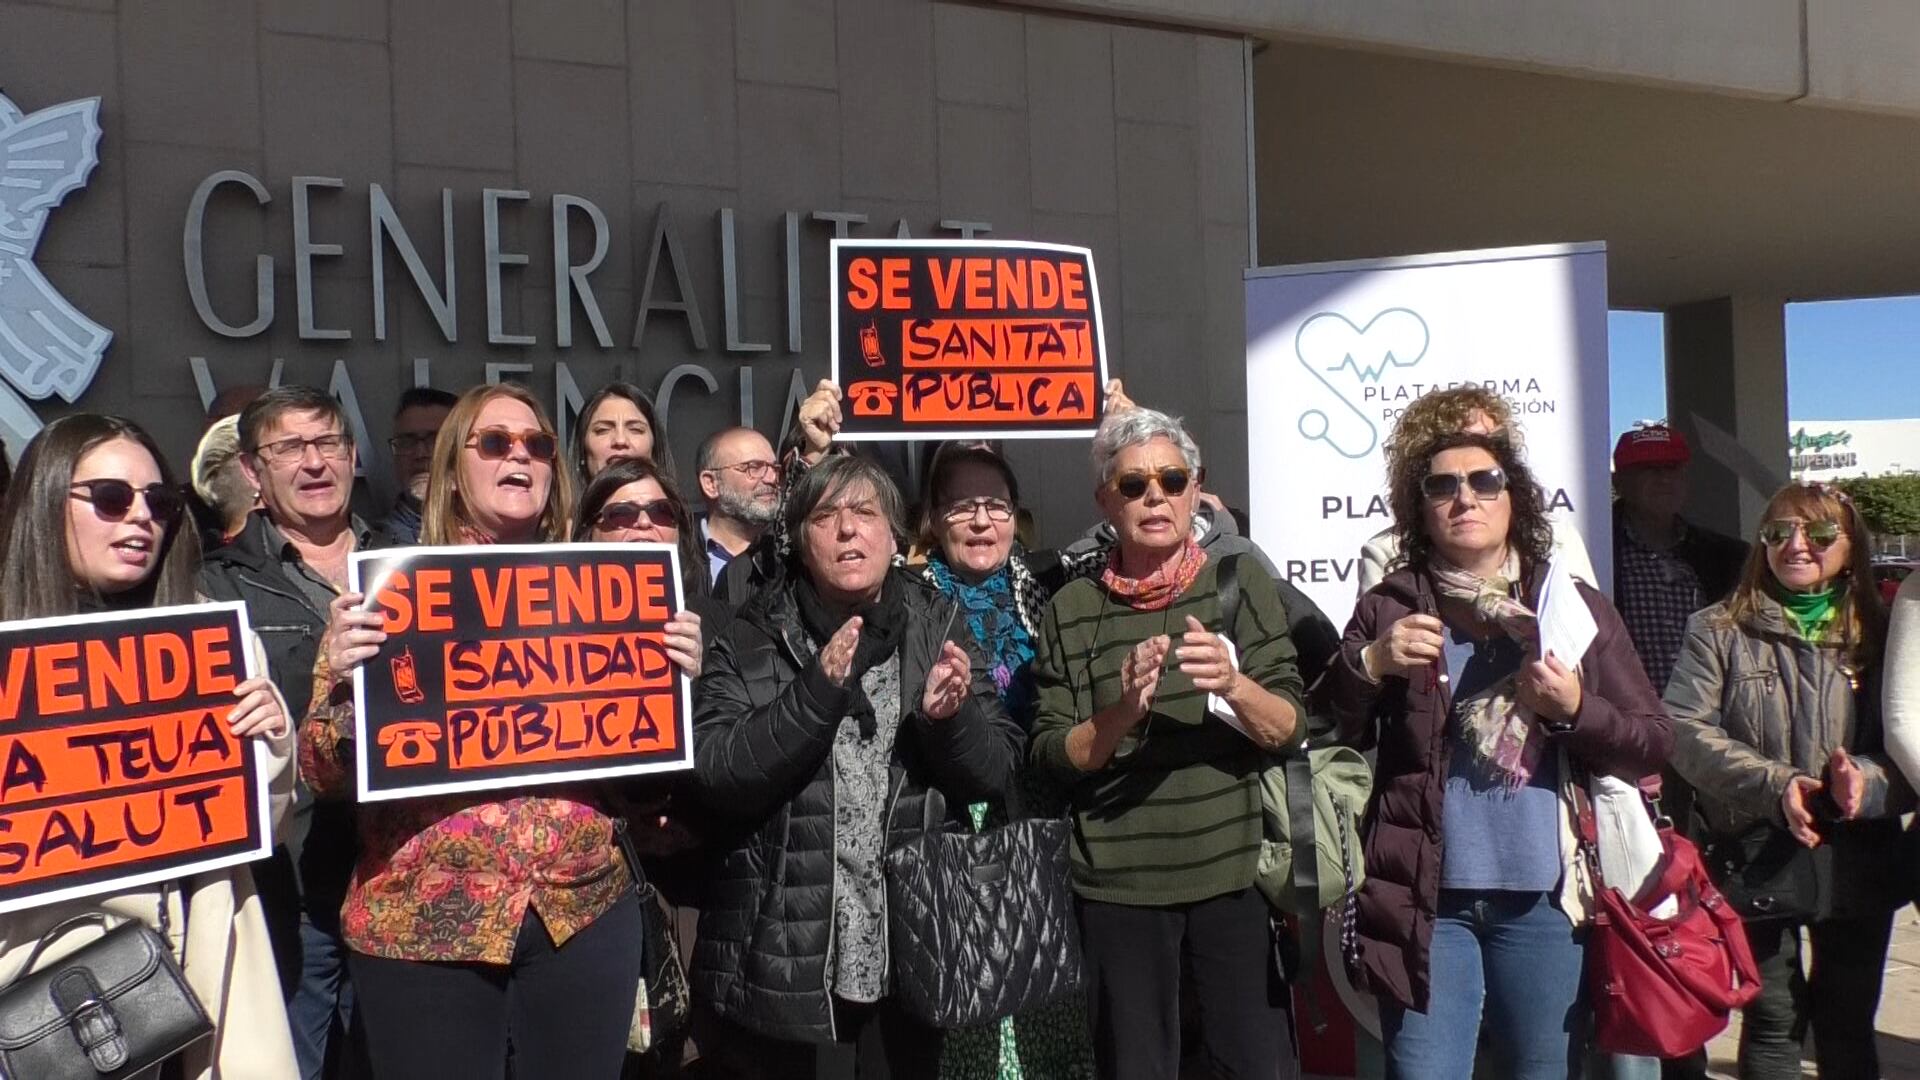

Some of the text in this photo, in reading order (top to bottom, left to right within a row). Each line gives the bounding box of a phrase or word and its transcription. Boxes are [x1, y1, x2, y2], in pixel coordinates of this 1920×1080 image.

[183, 169, 993, 351] GENERALI
[847, 257, 1088, 310] SE VENDE
[909, 318, 1086, 361] SANITAT
[906, 371, 1085, 416] PÚBLICA
[375, 563, 669, 634] SE VENDE
[0, 627, 236, 720] VENDE
[449, 637, 671, 691] SANIDAD
[67, 712, 230, 784] TEUA
[0, 785, 223, 875] SALUT
